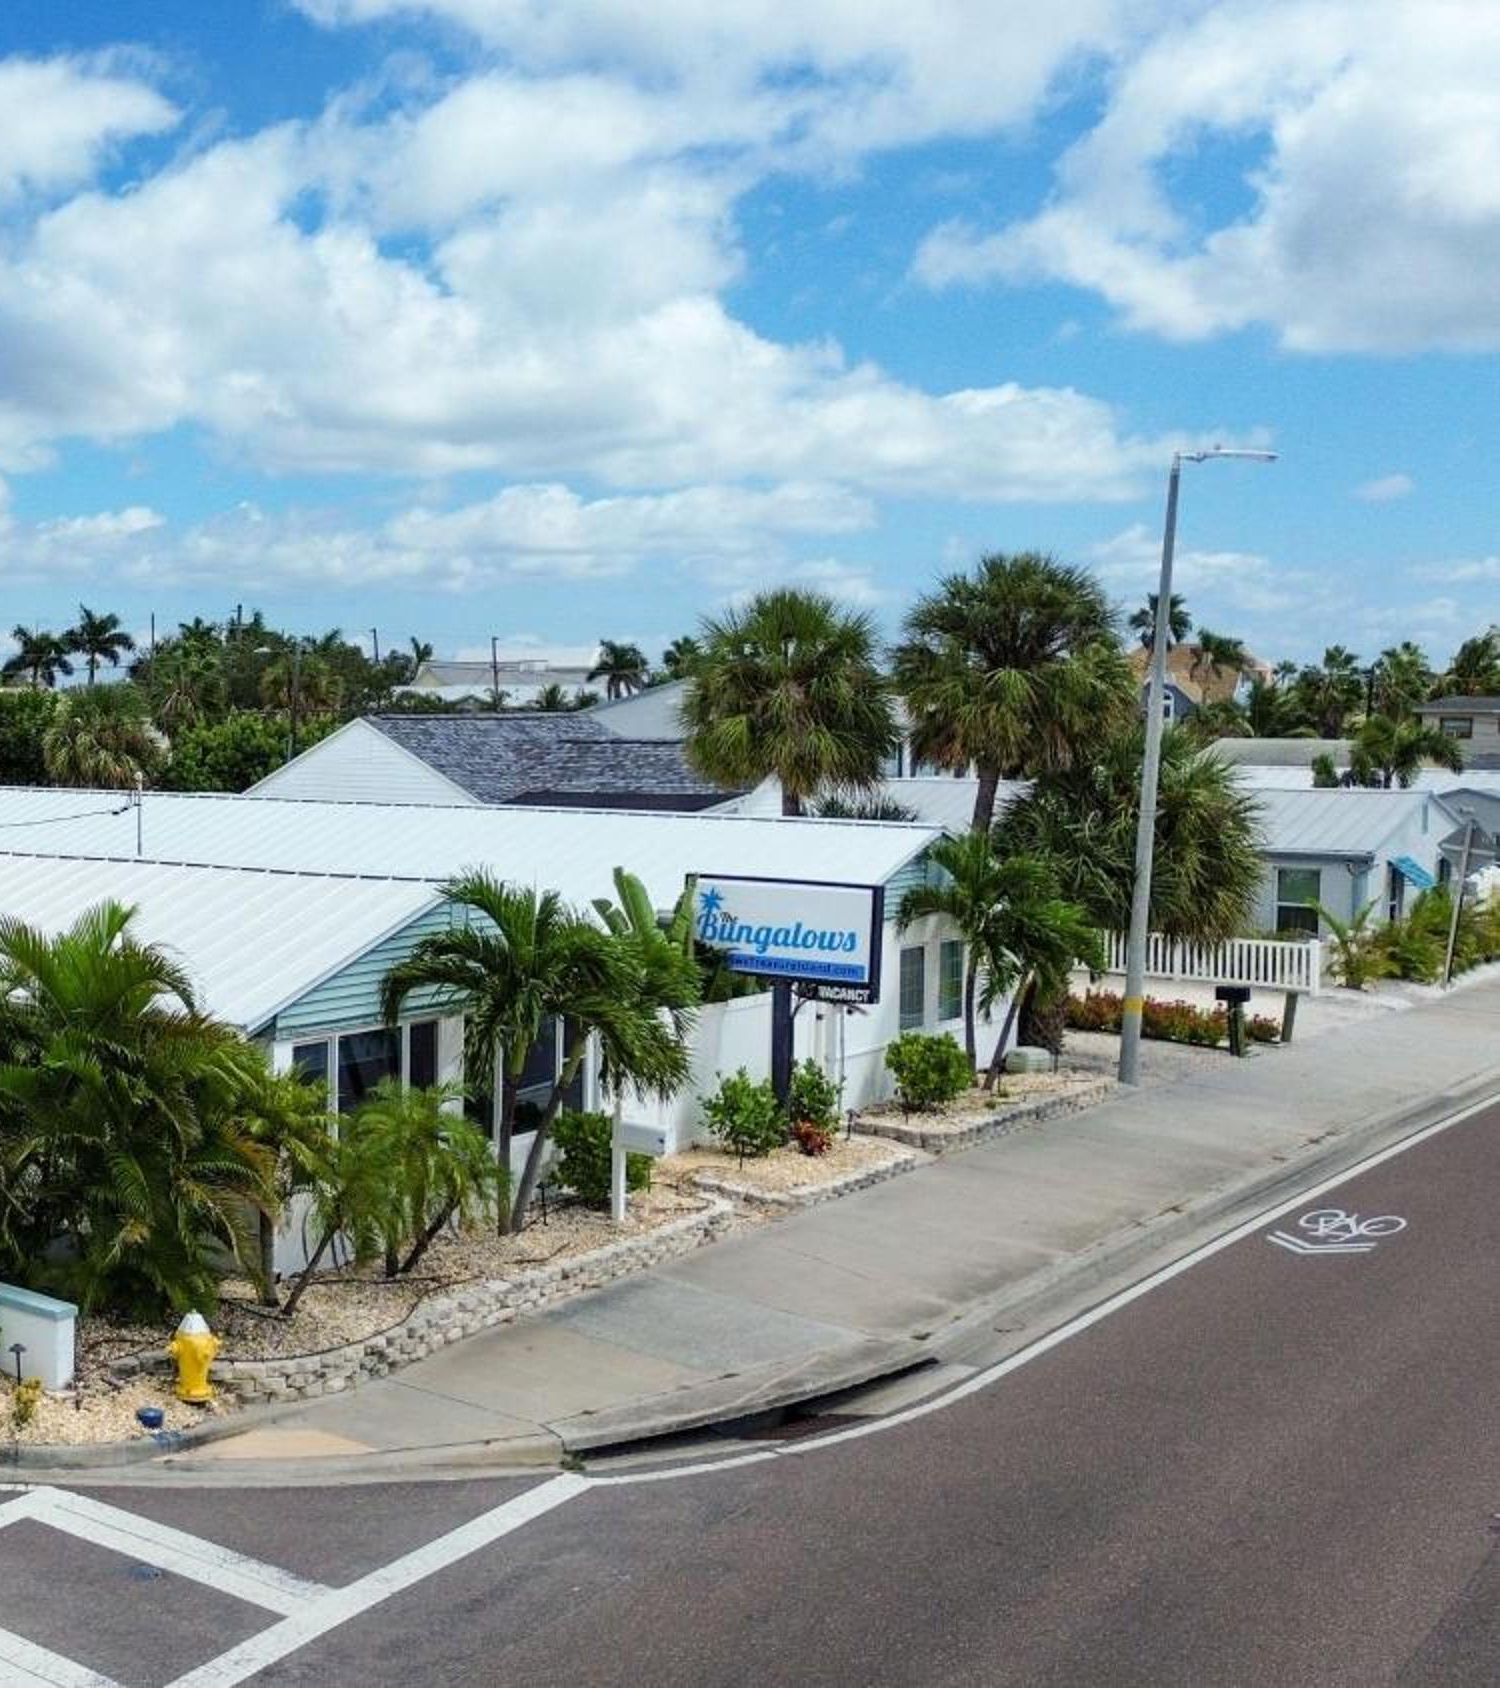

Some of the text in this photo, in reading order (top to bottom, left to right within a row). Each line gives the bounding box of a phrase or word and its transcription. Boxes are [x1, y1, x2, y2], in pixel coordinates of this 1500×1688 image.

[721, 912, 738, 923] The
[698, 912, 857, 954] Bungalows
[818, 986, 871, 1001] VACANCY
